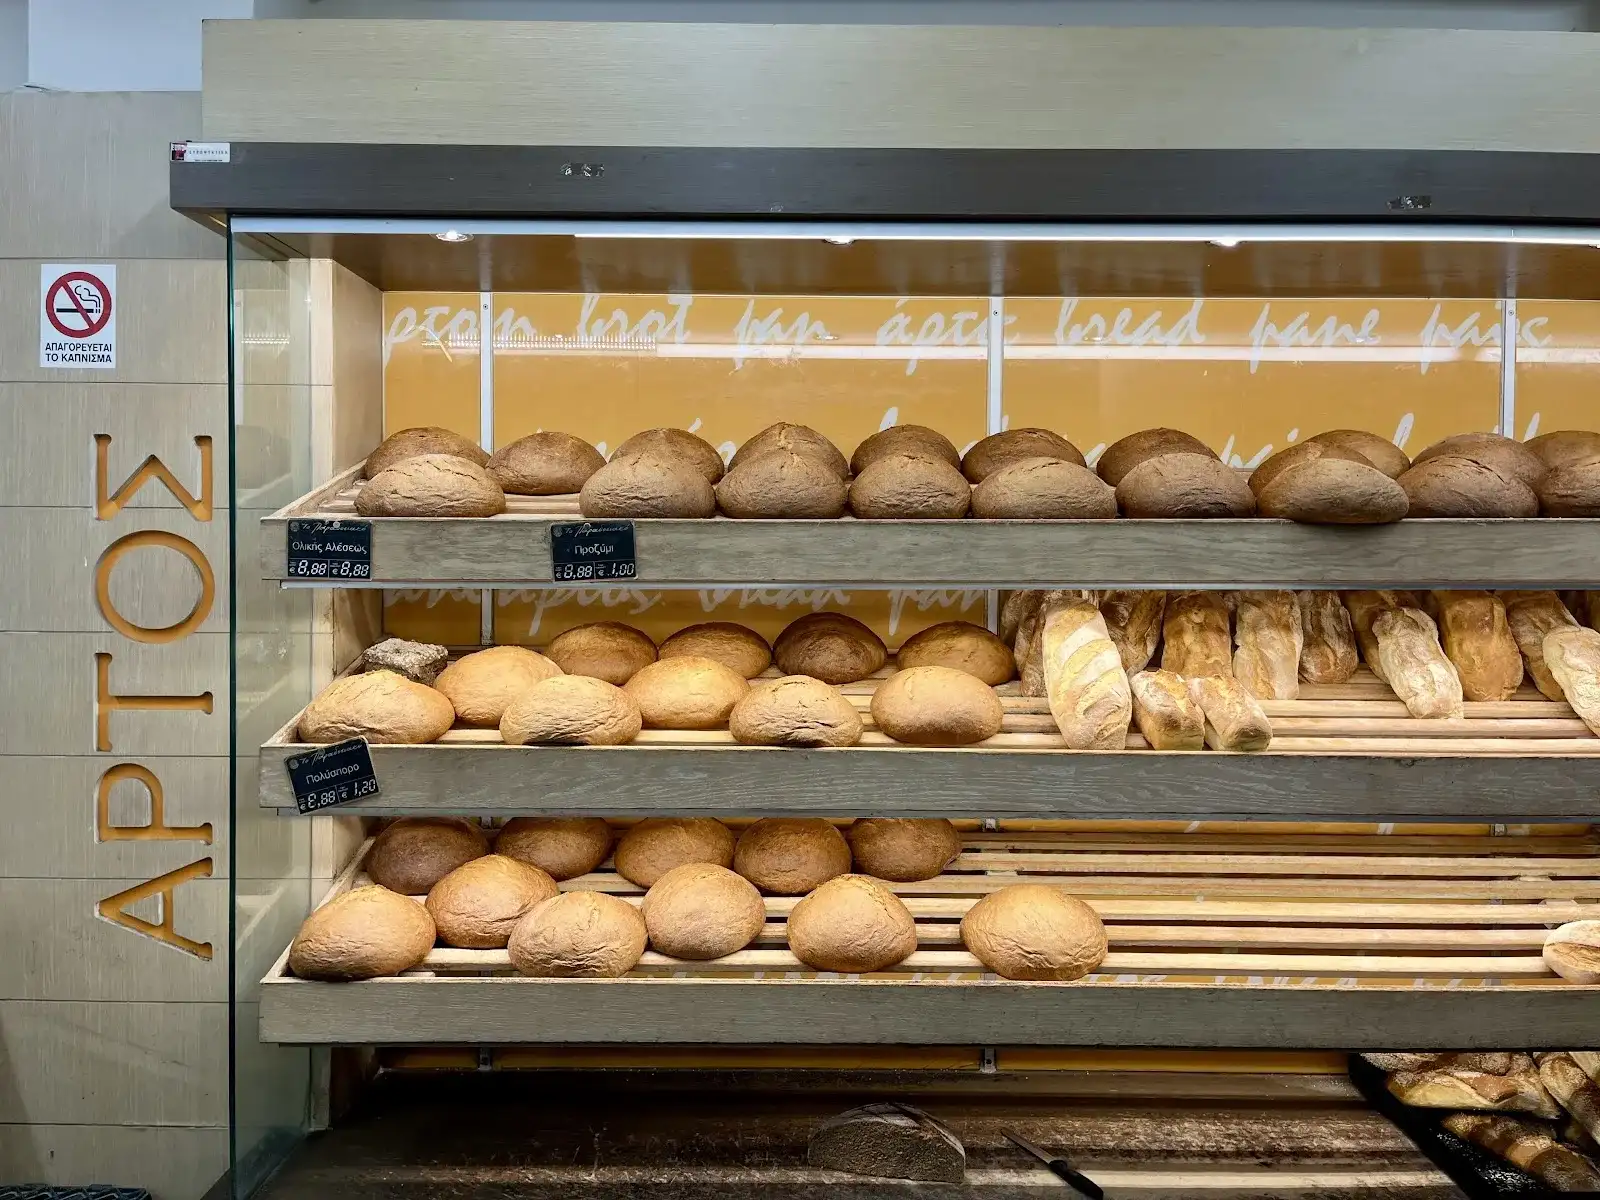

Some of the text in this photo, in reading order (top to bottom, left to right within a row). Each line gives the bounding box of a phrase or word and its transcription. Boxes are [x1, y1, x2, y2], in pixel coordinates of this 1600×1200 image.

[1055, 298, 1206, 347] bread
[45, 342, 112, 352] ΑΠΑΓΟΡΕΥΕΤΑΙ
[1249, 302, 1381, 375] pane
[45, 353, 112, 363] ΤΟ ΚΑΠΝΙΣΜΑ
[292, 541, 367, 554] Ολικής Αλέσεως
[574, 543, 614, 556] Προζύμι
[94, 433, 215, 962] ΑΡΤΟΣ
[306, 763, 360, 785] Πολύσπορο
[354, 778, 376, 797] 1,20
